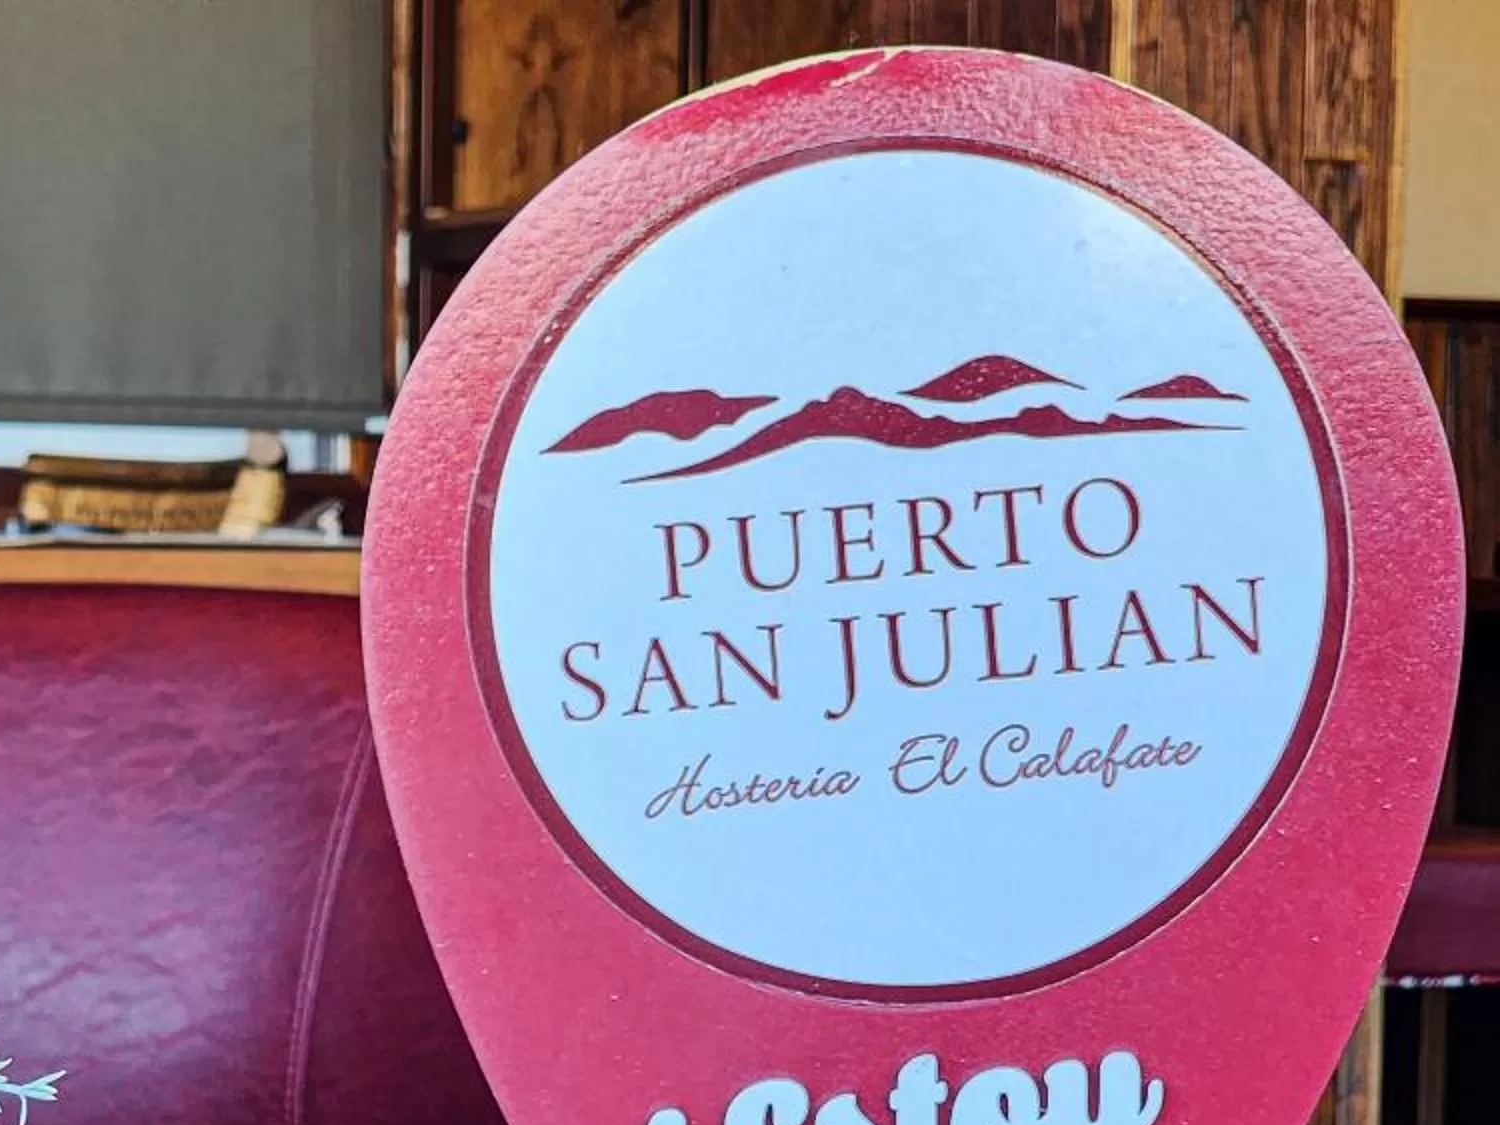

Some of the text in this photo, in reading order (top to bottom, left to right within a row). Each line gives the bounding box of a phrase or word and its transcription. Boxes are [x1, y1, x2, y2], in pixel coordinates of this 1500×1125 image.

[654, 477, 1140, 601] PUERTO
[560, 576, 1266, 722] SAN JULIAN
[889, 734, 967, 796] El
[979, 724, 1203, 789] Calafate
